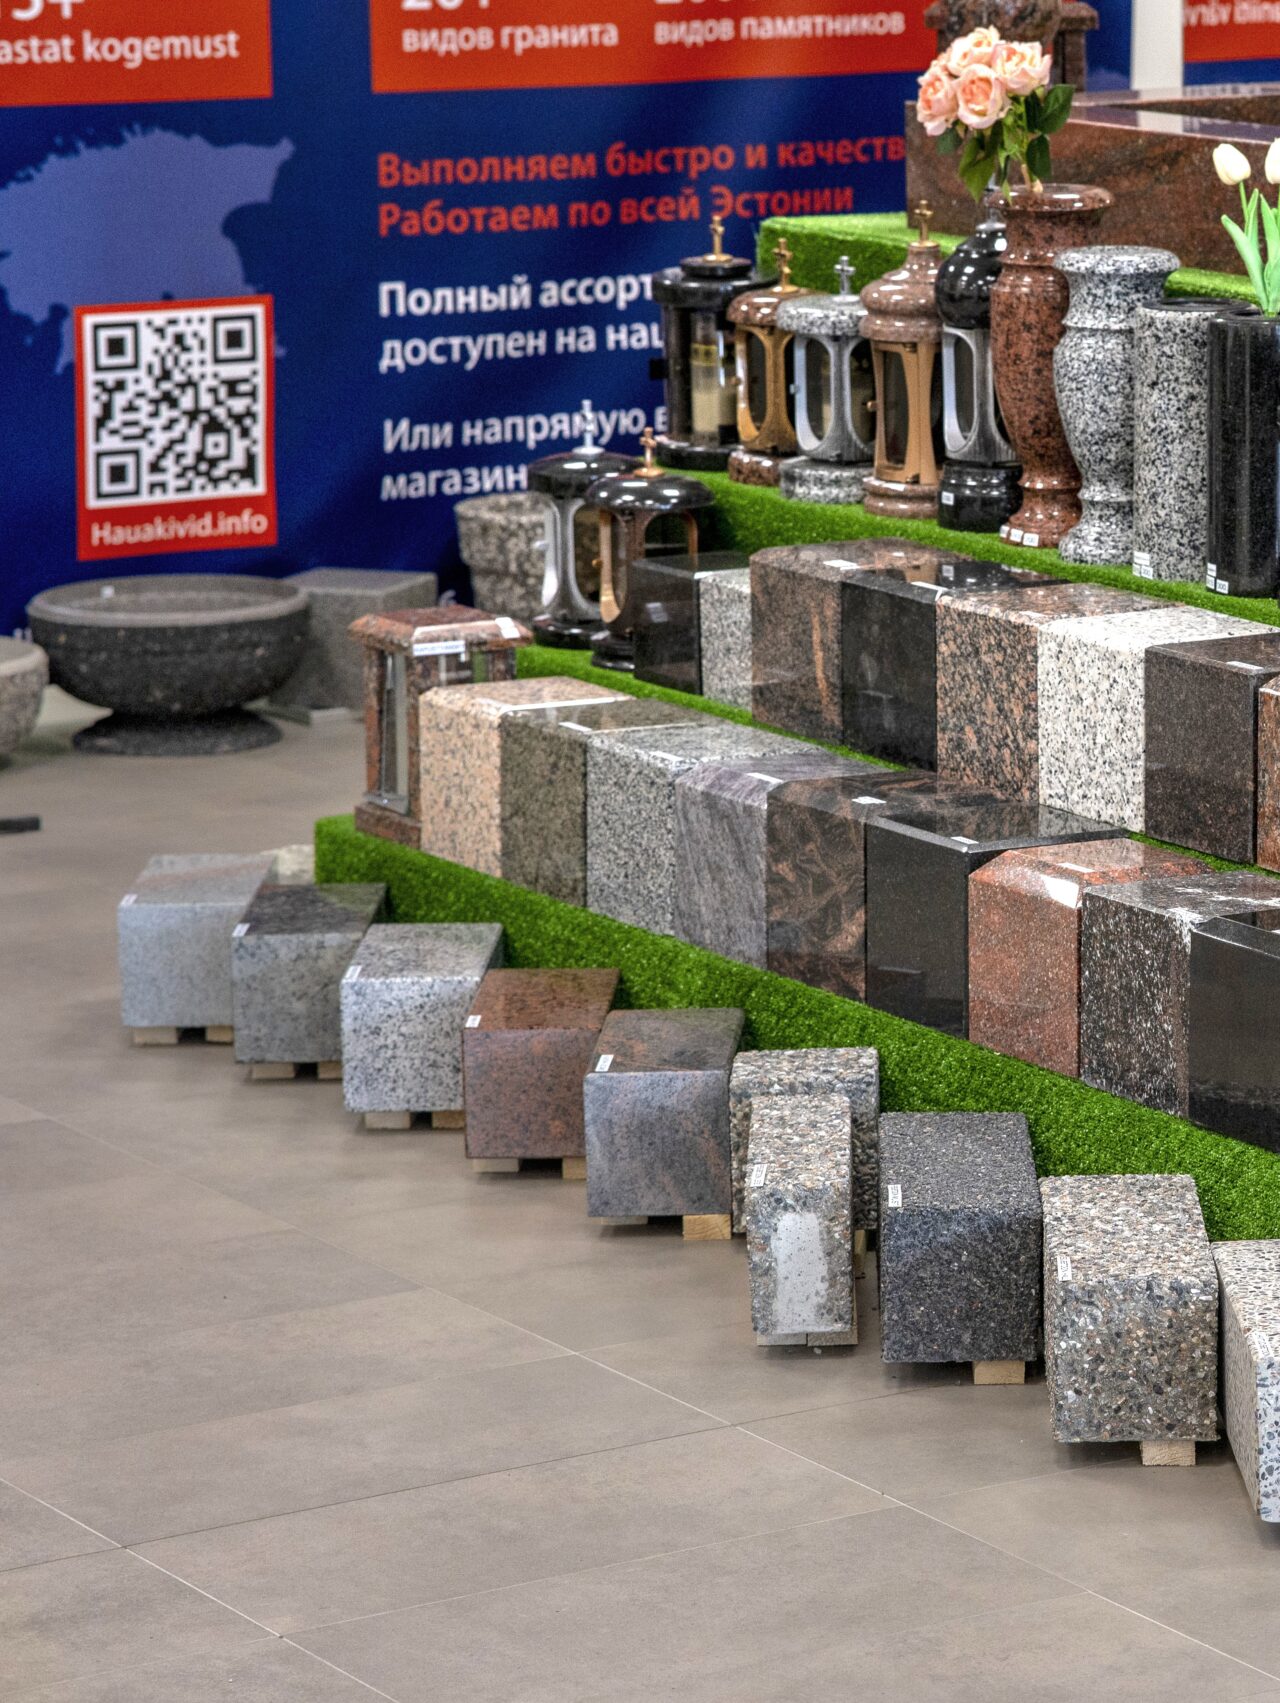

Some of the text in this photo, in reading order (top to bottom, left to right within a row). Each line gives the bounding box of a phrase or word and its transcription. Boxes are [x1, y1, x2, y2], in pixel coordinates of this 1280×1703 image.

[82, 29, 240, 69] kogemust
[402, 23, 619, 57] видов гранита
[654, 11, 906, 48] видов памятников
[377, 151, 597, 188] Выполняем
[605, 141, 734, 179] быстро
[745, 142, 767, 169] и
[379, 185, 854, 237] Работаем по всей Эстонии
[378, 274, 532, 317] Полный
[378, 327, 547, 373] доступен
[555, 325, 597, 354] на
[383, 417, 453, 453] Или
[90, 508, 269, 547] Hauakivid.info
